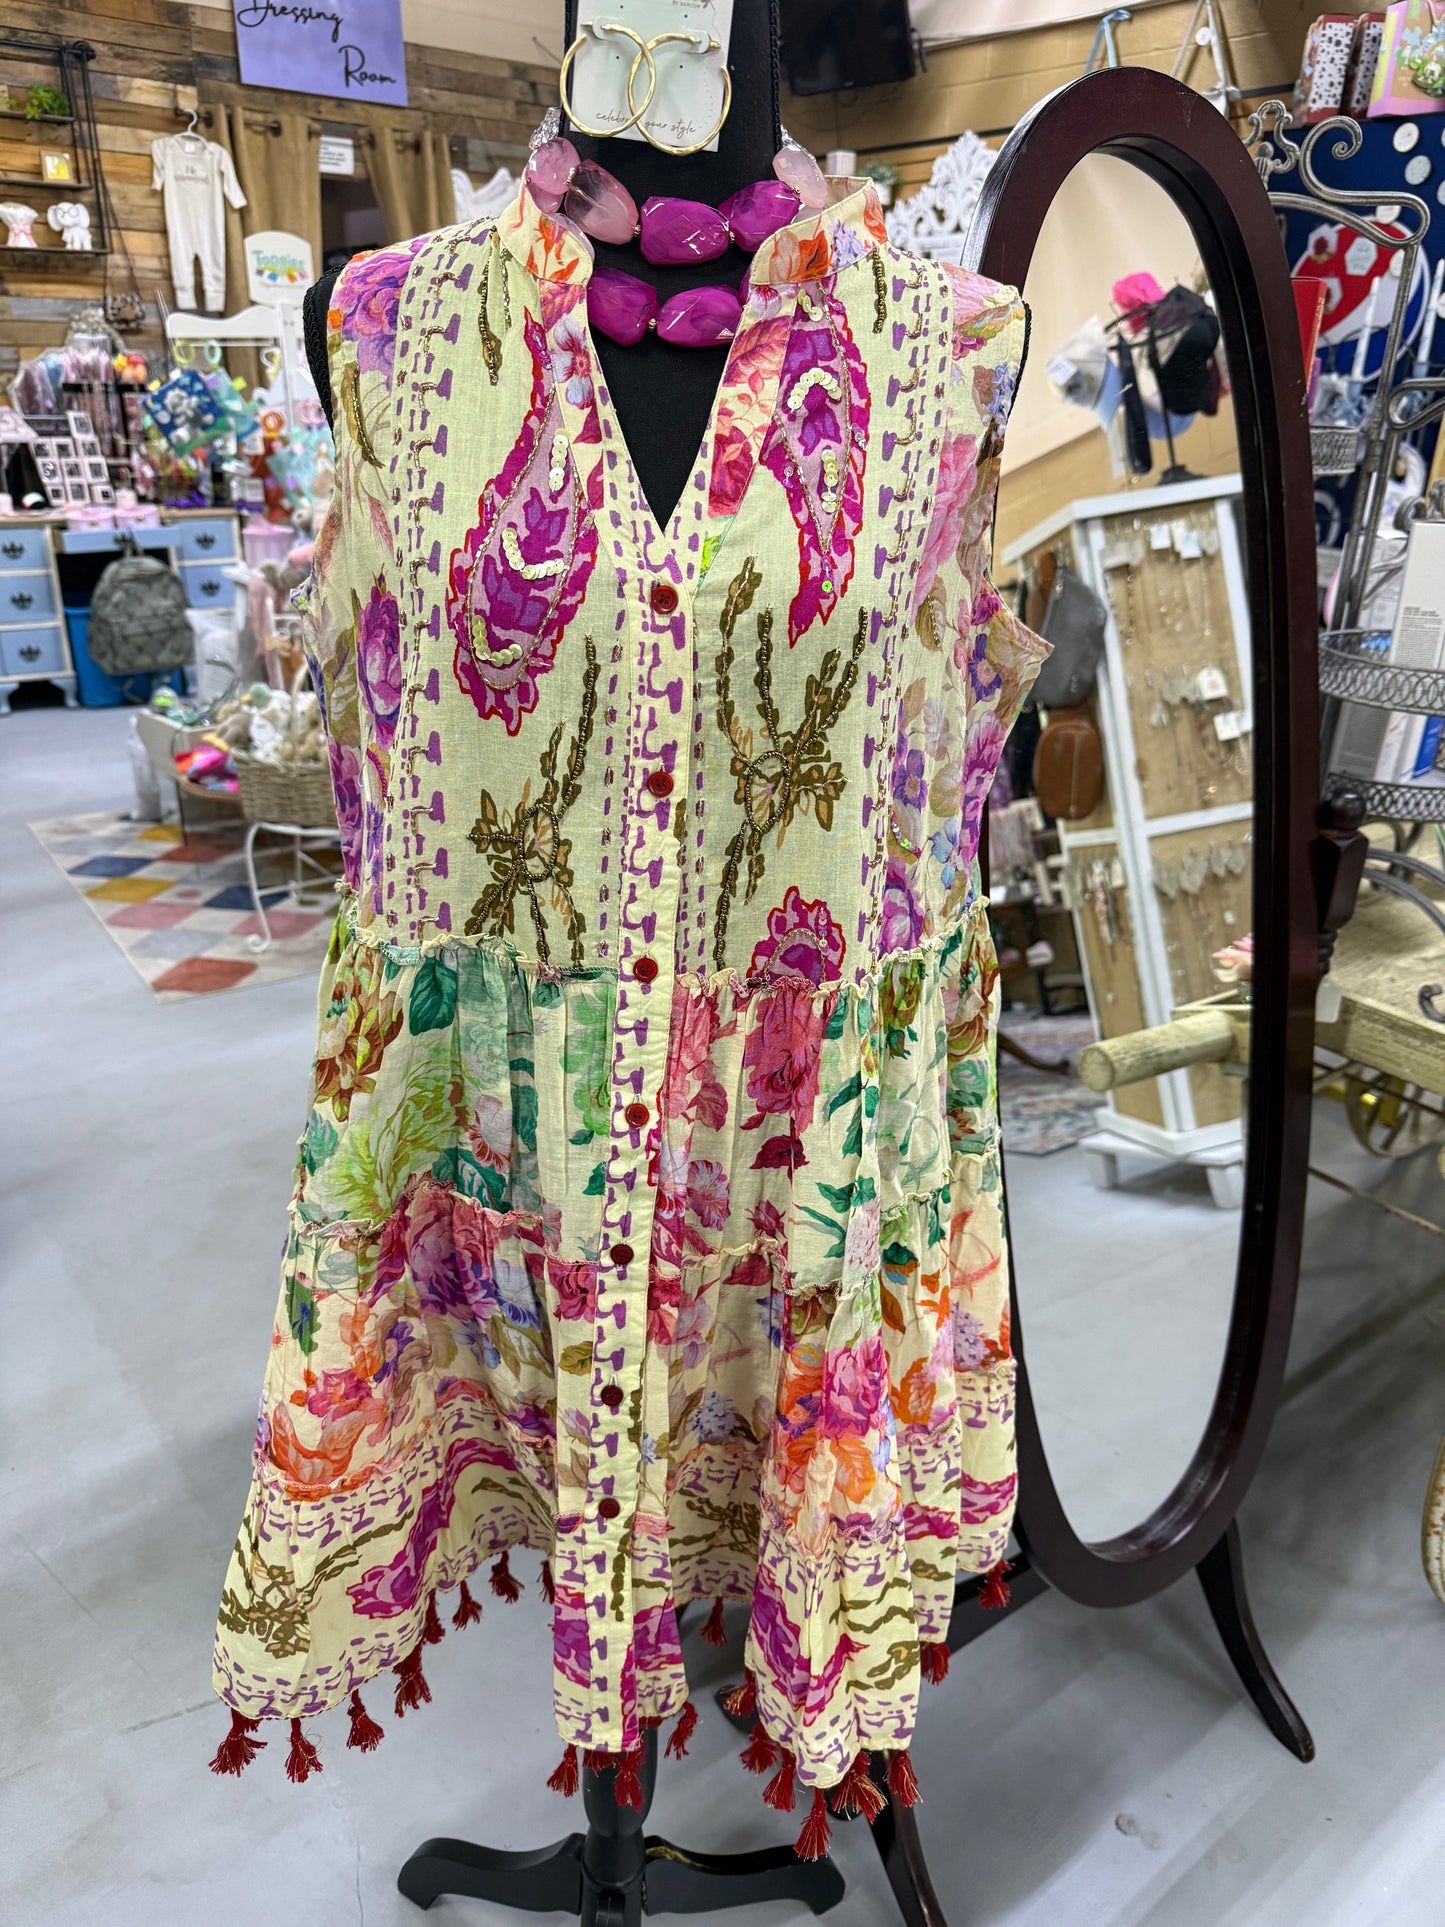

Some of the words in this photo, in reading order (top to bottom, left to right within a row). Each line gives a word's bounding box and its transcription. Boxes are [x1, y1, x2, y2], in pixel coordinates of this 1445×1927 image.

[237, 0, 344, 43] Dressing
[338, 45, 397, 89] Room
[595, 108, 631, 123] celebr
[671, 118, 697, 140] style
